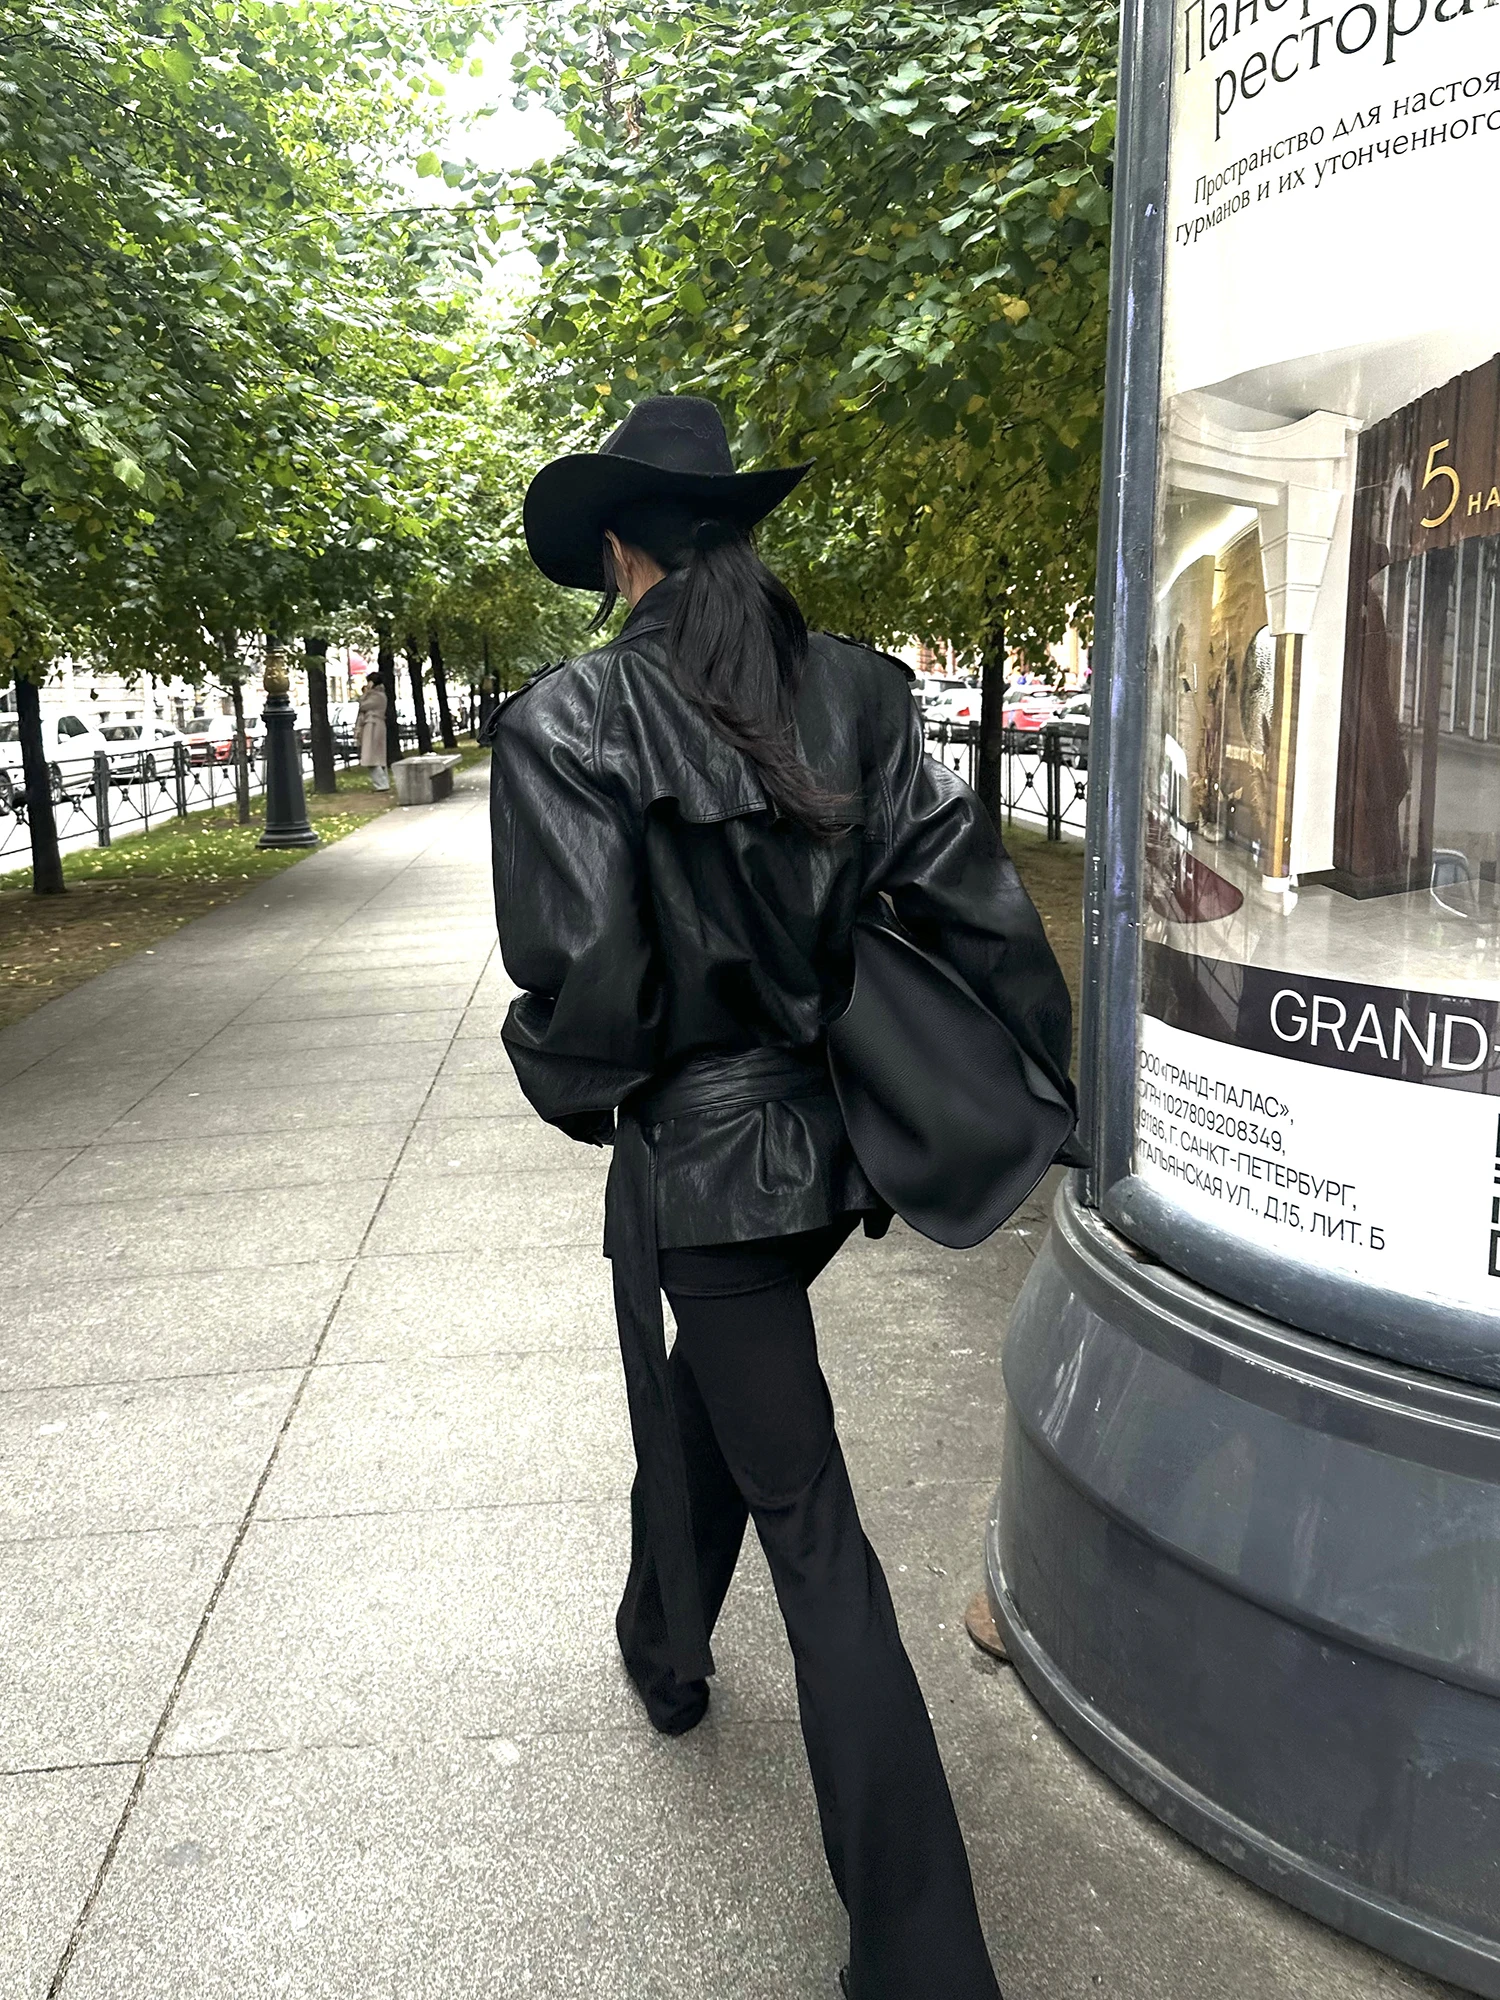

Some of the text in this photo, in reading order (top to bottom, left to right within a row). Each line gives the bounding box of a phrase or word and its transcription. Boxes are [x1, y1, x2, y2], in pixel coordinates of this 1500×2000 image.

[1214, 0, 1500, 141] рестор
[1194, 71, 1500, 206] Пространство для настоя
[1175, 190, 1251, 246] гурманов
[1257, 180, 1270, 202] и
[1279, 167, 1306, 194] их
[1419, 438, 1460, 529] 5
[1138, 1106, 1357, 1211] 91186, Г. САНКТ-ПЕТЕРБУРГ,
[1163, 1092, 1286, 1156] 1027809208349,
[1226, 1181, 1259, 1215] УЛ.,
[1263, 1195, 1304, 1232] Д.15,
[1310, 1212, 1363, 1246] ЛИТ.
[1370, 1226, 1385, 1250] Б
